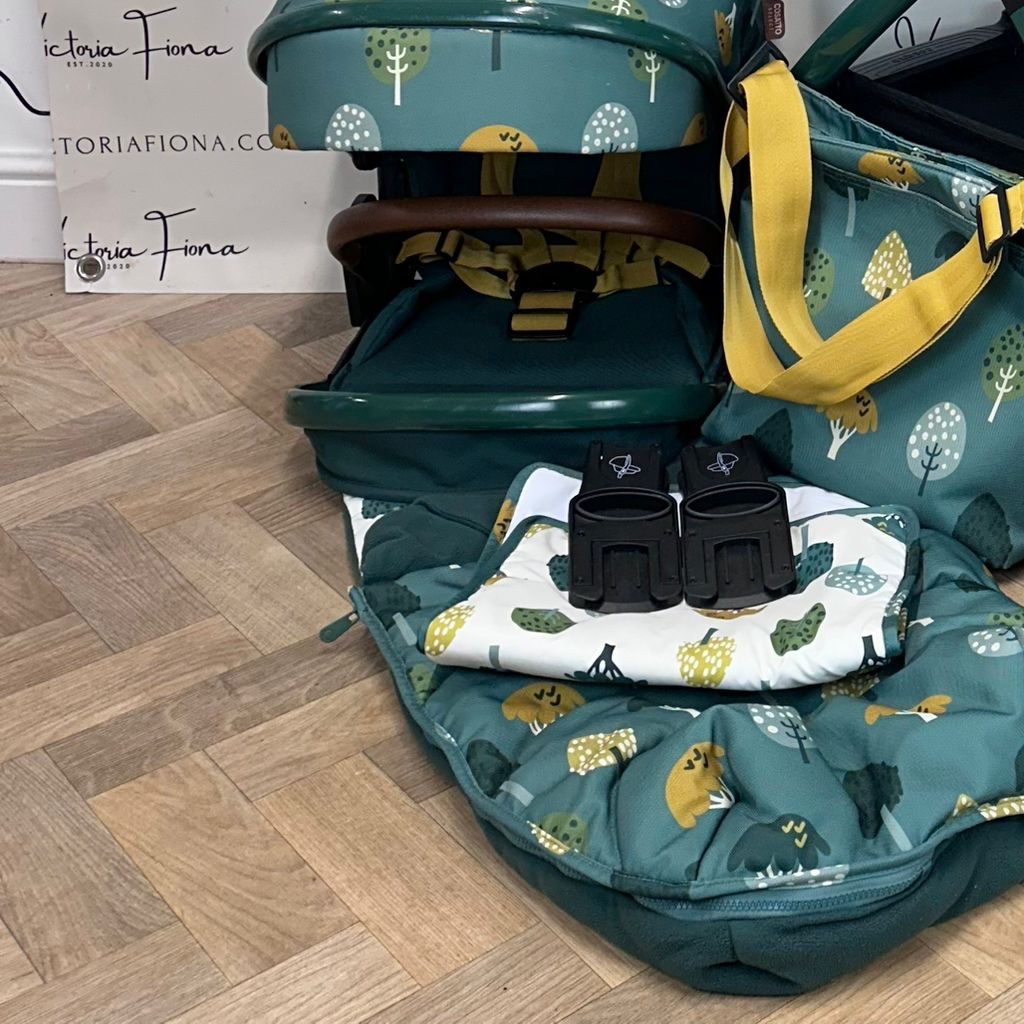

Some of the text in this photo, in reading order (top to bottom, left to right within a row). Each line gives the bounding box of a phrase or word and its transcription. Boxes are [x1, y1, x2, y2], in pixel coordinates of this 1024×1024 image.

[41, 7, 234, 81] ictoria Fiona
[773, 3, 783, 36] COSATTO
[51, 133, 275, 156] TORIAFIONA.CO
[61, 208, 250, 282] ictoria Fiona
